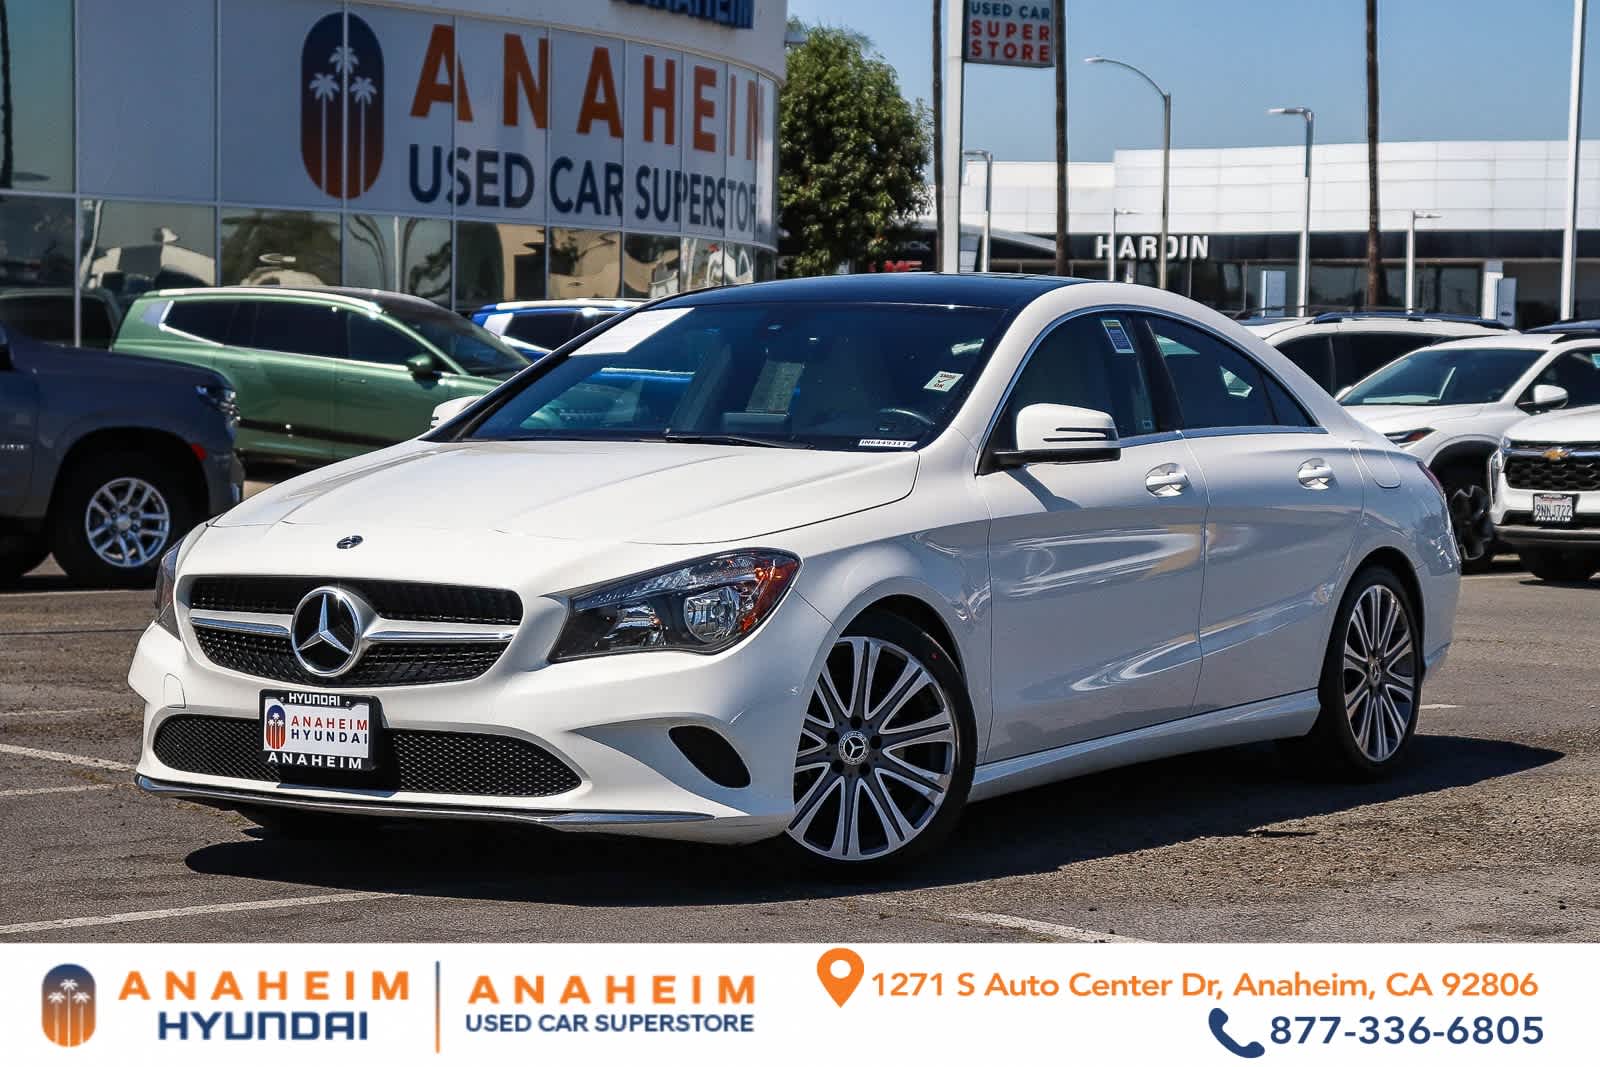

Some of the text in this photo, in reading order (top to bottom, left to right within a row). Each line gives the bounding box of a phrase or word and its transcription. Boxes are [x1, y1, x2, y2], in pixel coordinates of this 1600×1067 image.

[971, 1, 1050, 20] USED CAR
[970, 19, 1050, 41] SUPER
[970, 39, 1050, 62] STORE
[409, 143, 536, 209] USED
[549, 155, 624, 217] CAR
[1095, 235, 1210, 260] HARDIN
[288, 692, 341, 706] HYUNDAI
[291, 715, 368, 731] ANAHEIM
[291, 729, 368, 744] HYUNDAI
[267, 752, 363, 769] ANAHEIM
